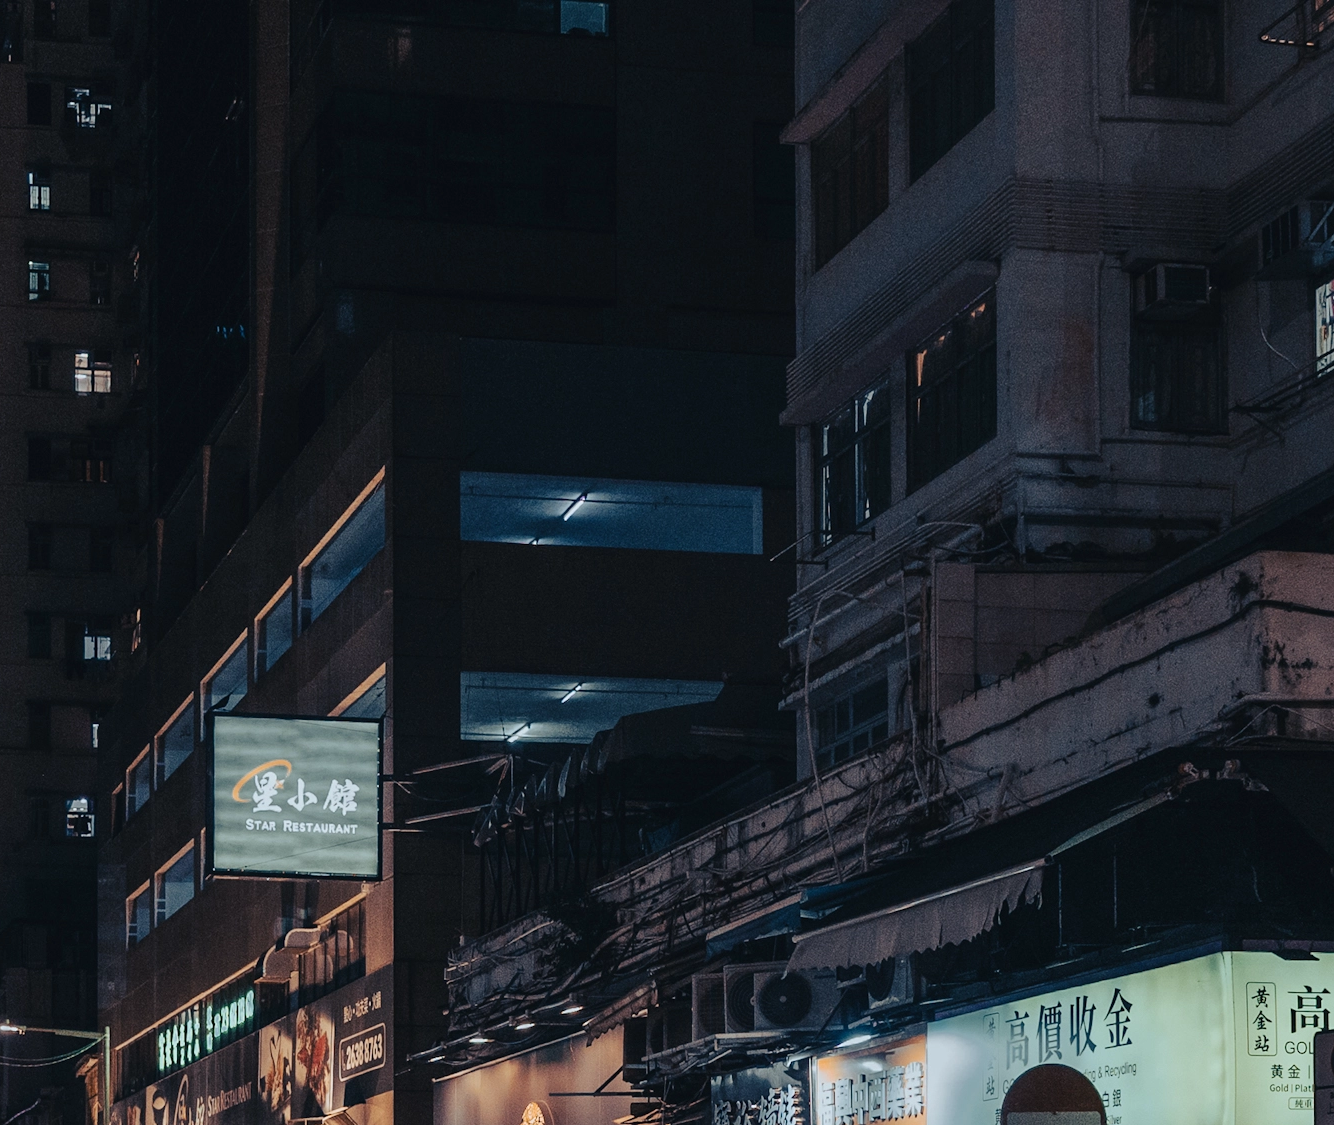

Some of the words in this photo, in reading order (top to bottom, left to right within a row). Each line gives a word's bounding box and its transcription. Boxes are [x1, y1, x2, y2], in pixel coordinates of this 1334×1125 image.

[253, 771, 360, 816] 星小館
[246, 818, 276, 831] STAR
[283, 820, 358, 834] RESTAURANT
[1005, 988, 1133, 1070] 高價收金
[346, 1040, 364, 1070] 2638
[364, 1033, 383, 1063] 8763
[1285, 1041, 1314, 1054] GOL
[1104, 1062, 1137, 1079] Recycling
[1269, 1084, 1289, 1093] Gold
[1102, 1089, 1122, 1108] 白銀
